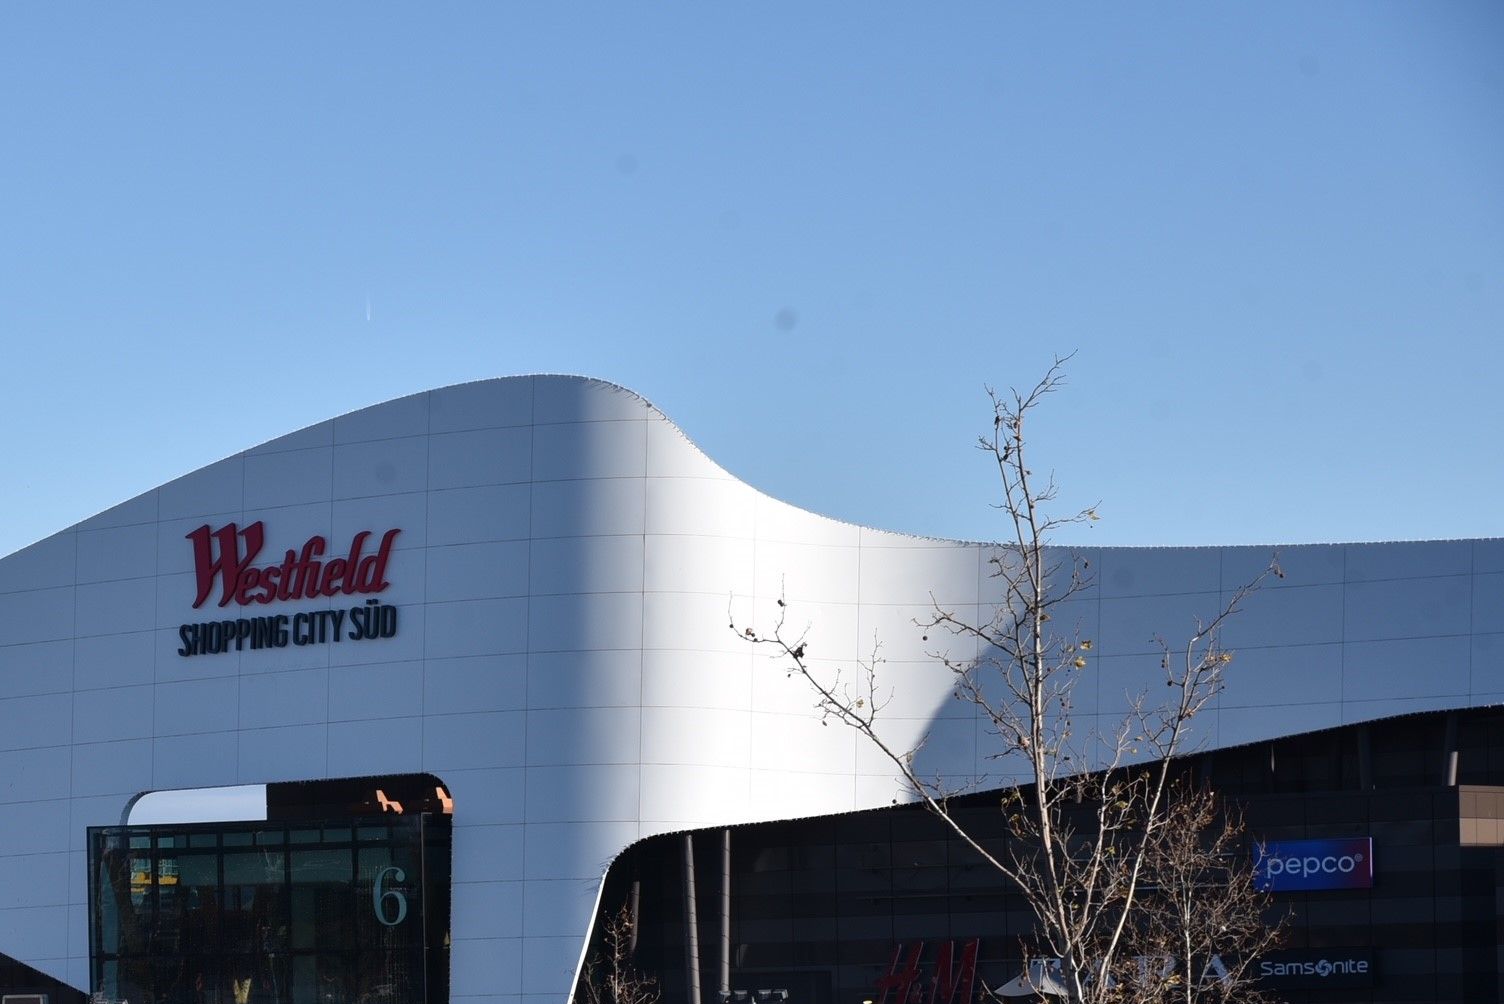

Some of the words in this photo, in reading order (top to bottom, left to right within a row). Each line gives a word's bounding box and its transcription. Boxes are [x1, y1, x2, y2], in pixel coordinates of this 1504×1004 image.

[185, 520, 402, 609] Westfield
[178, 614, 288, 658] SHOPPING
[293, 609, 345, 646] CITY
[349, 599, 397, 640] SÜD
[373, 866, 407, 926] 6
[1267, 854, 1356, 879] pepco
[1260, 959, 1369, 978] Samsonite
